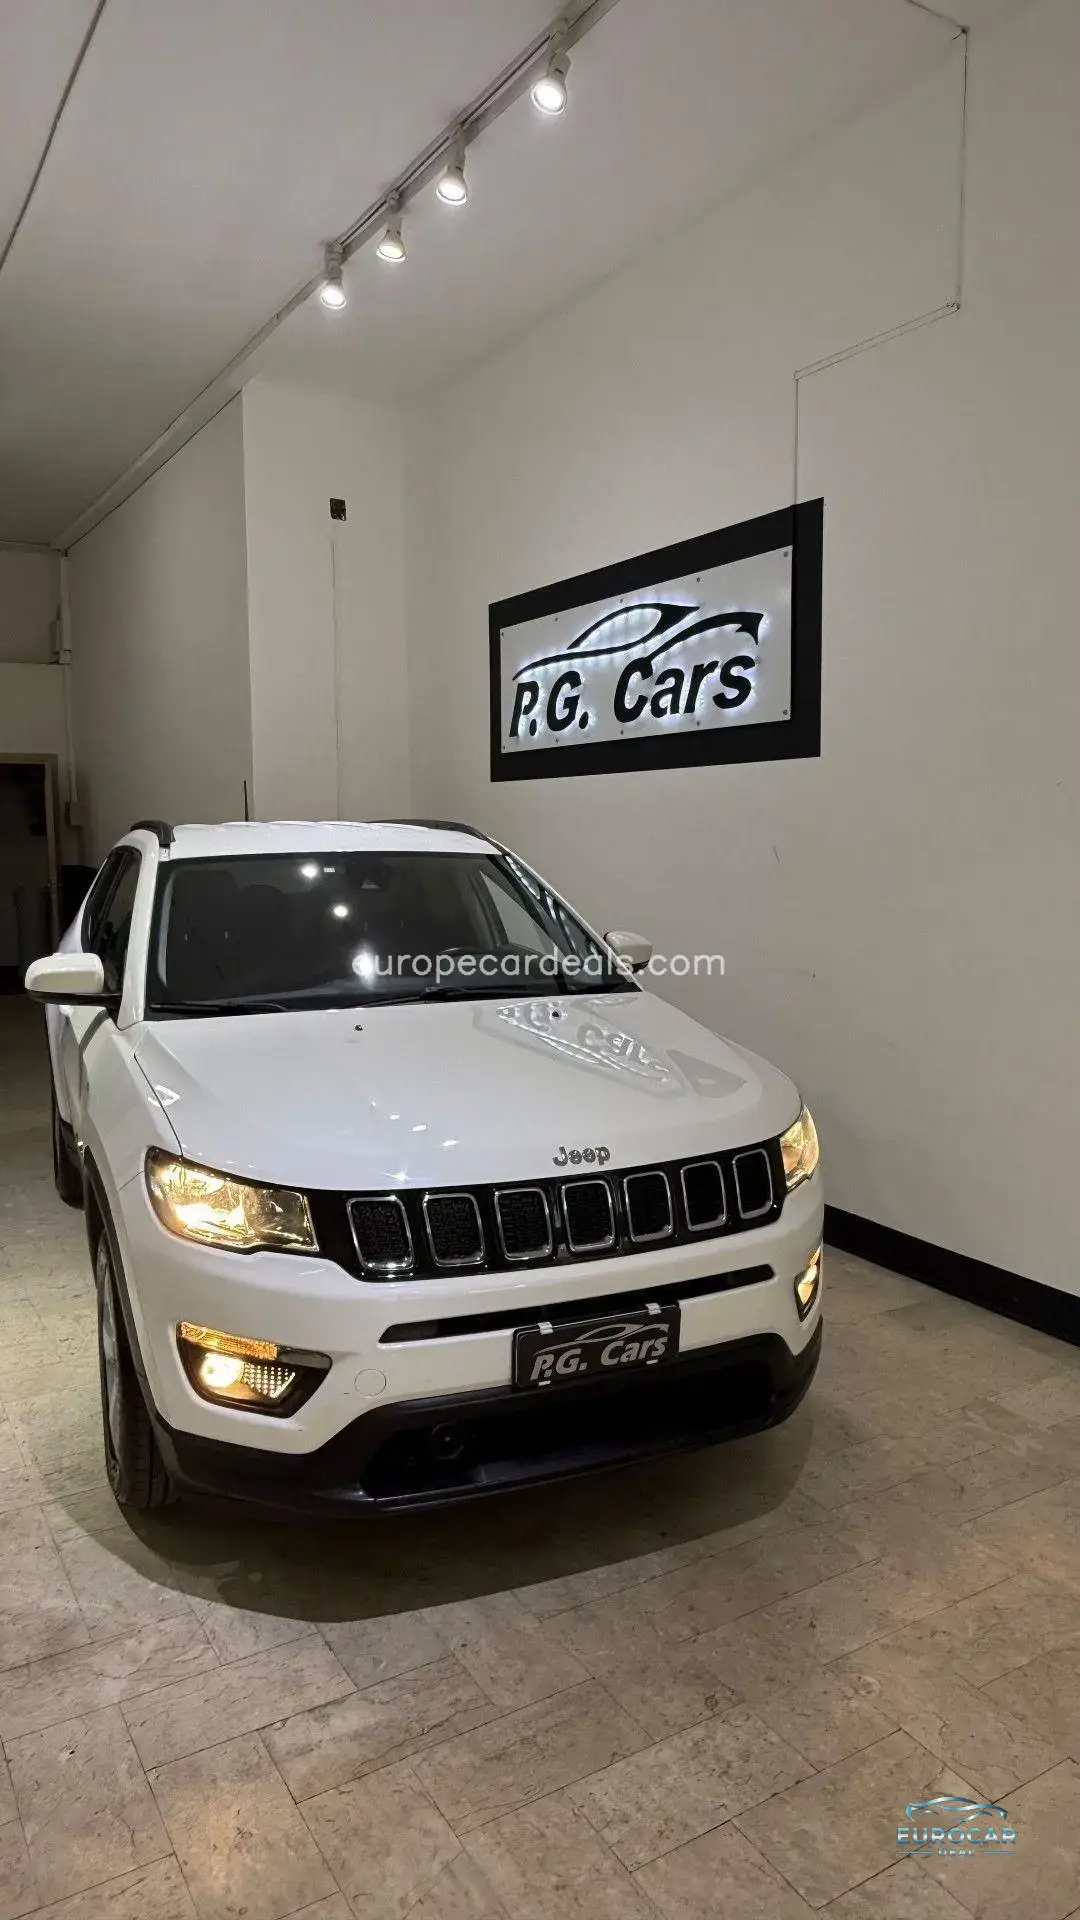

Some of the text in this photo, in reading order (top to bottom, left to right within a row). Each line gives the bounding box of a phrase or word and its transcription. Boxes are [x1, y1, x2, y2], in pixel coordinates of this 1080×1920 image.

[509, 655, 755, 737] P.G. Cars
[552, 1146, 611, 1167] Jeep
[530, 1337, 668, 1381] P.G. Cars
